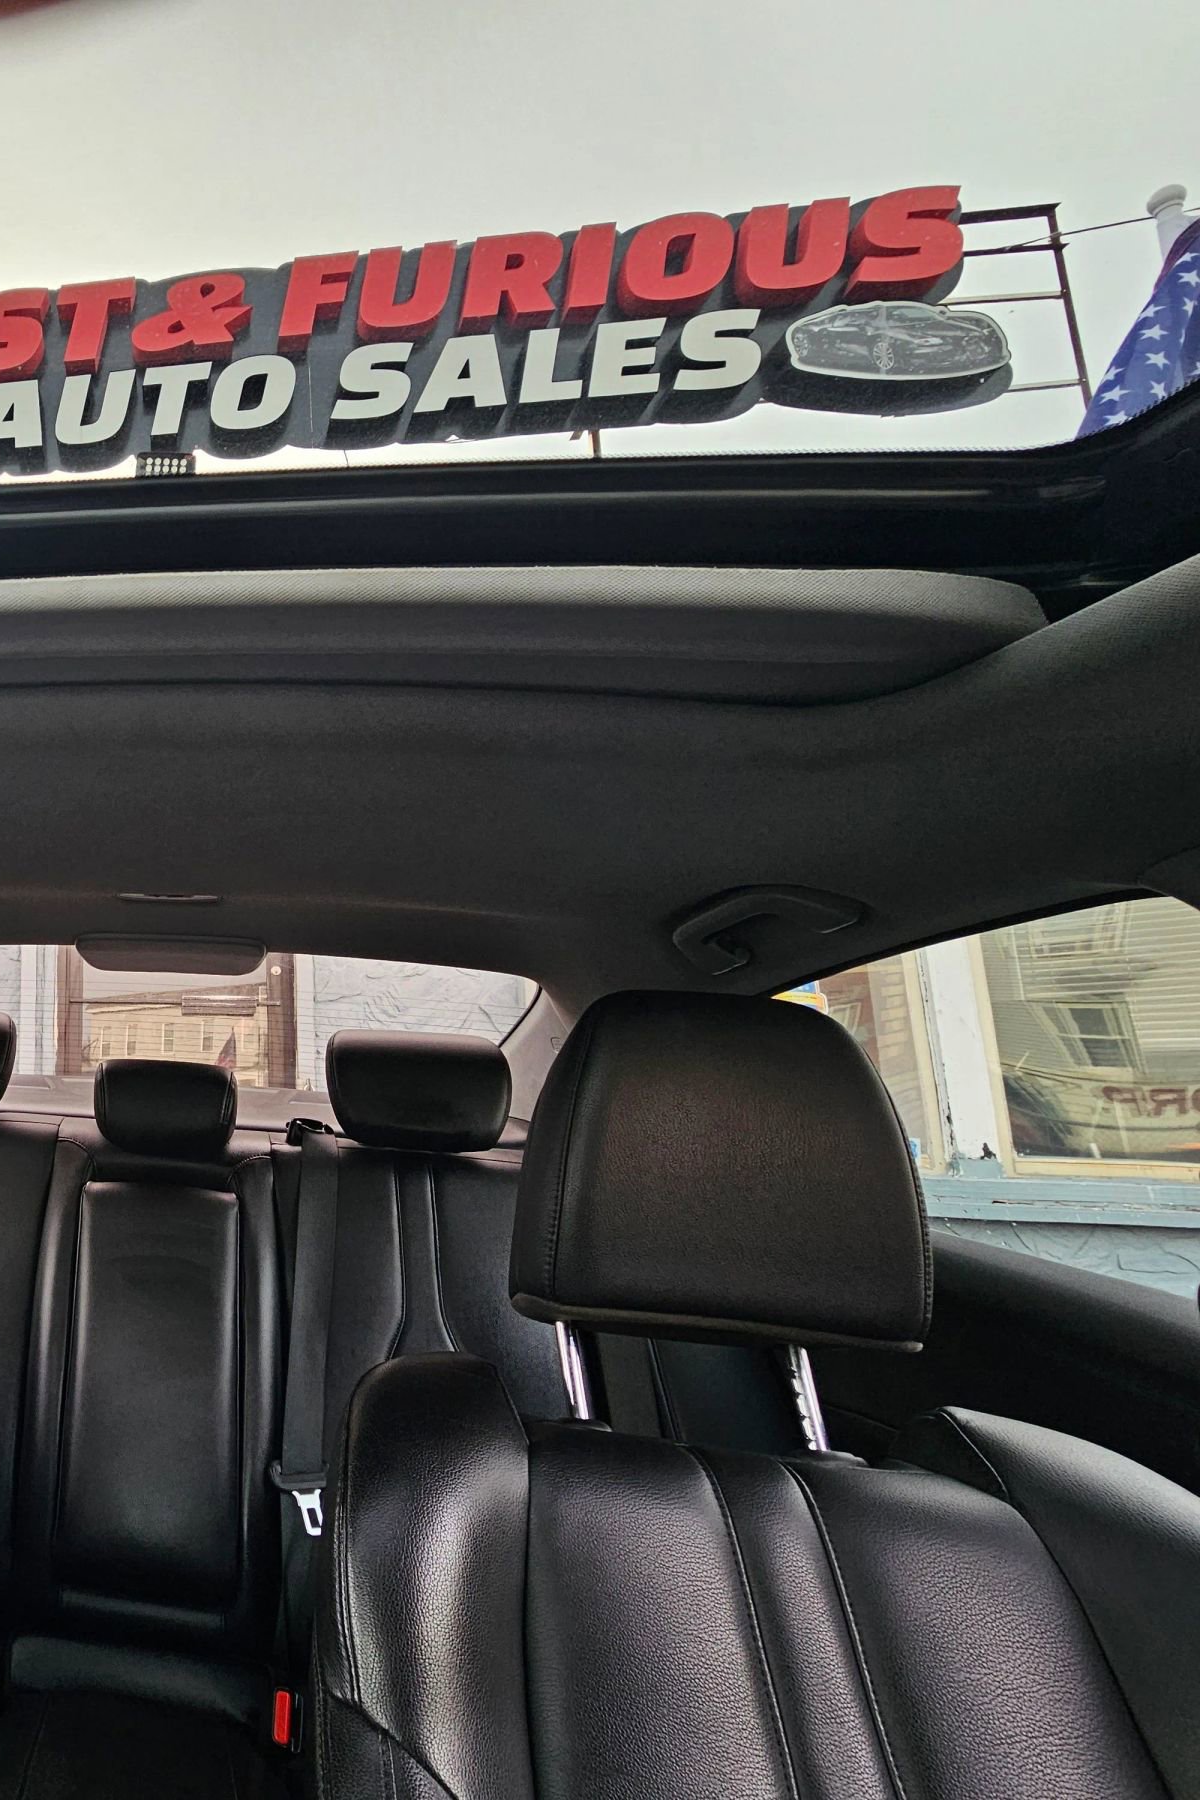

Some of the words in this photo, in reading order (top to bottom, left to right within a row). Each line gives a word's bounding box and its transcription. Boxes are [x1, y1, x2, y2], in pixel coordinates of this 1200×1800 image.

[132, 273, 252, 366] &
[277, 185, 963, 352] FURIOUS
[330, 308, 763, 421] SALES
